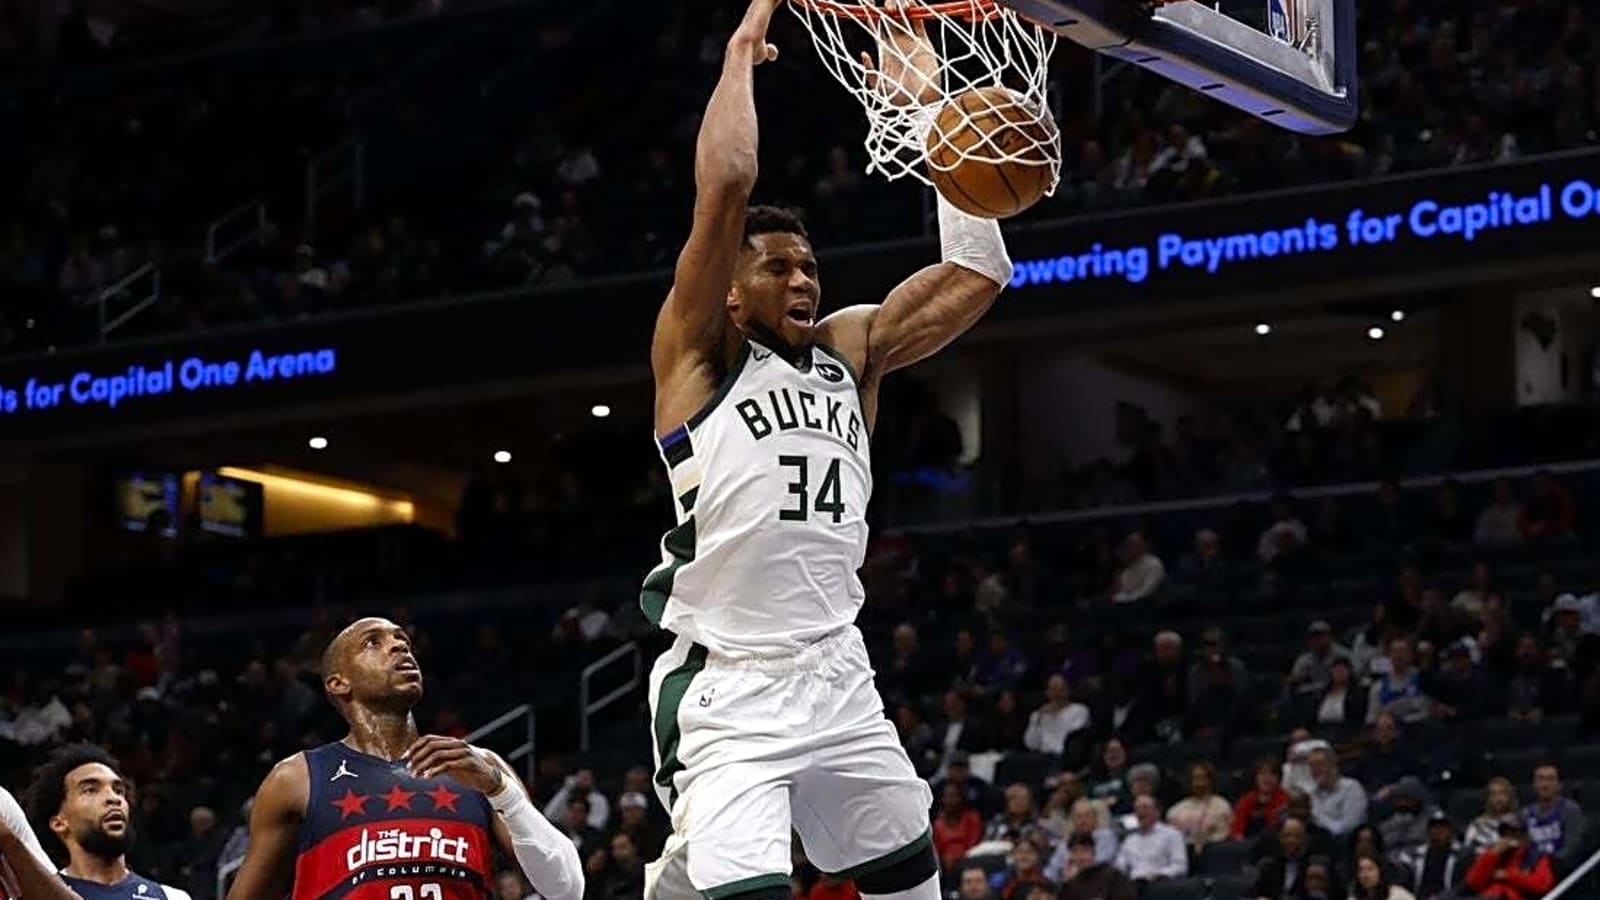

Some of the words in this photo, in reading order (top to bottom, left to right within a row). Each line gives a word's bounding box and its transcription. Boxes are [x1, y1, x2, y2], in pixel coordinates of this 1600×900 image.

[1158, 217, 1338, 273] Payments
[1347, 209, 1402, 245] for
[1409, 184, 1551, 240] Capital
[1561, 180, 1600, 218] O
[25, 379, 65, 409] for
[70, 362, 173, 407] Capital
[179, 358, 240, 390] One
[245, 349, 335, 382] Arena
[735, 388, 861, 452] BUCKS
[779, 455, 845, 523] 34
[346, 827, 469, 872] district
[377, 828, 400, 838] THE
